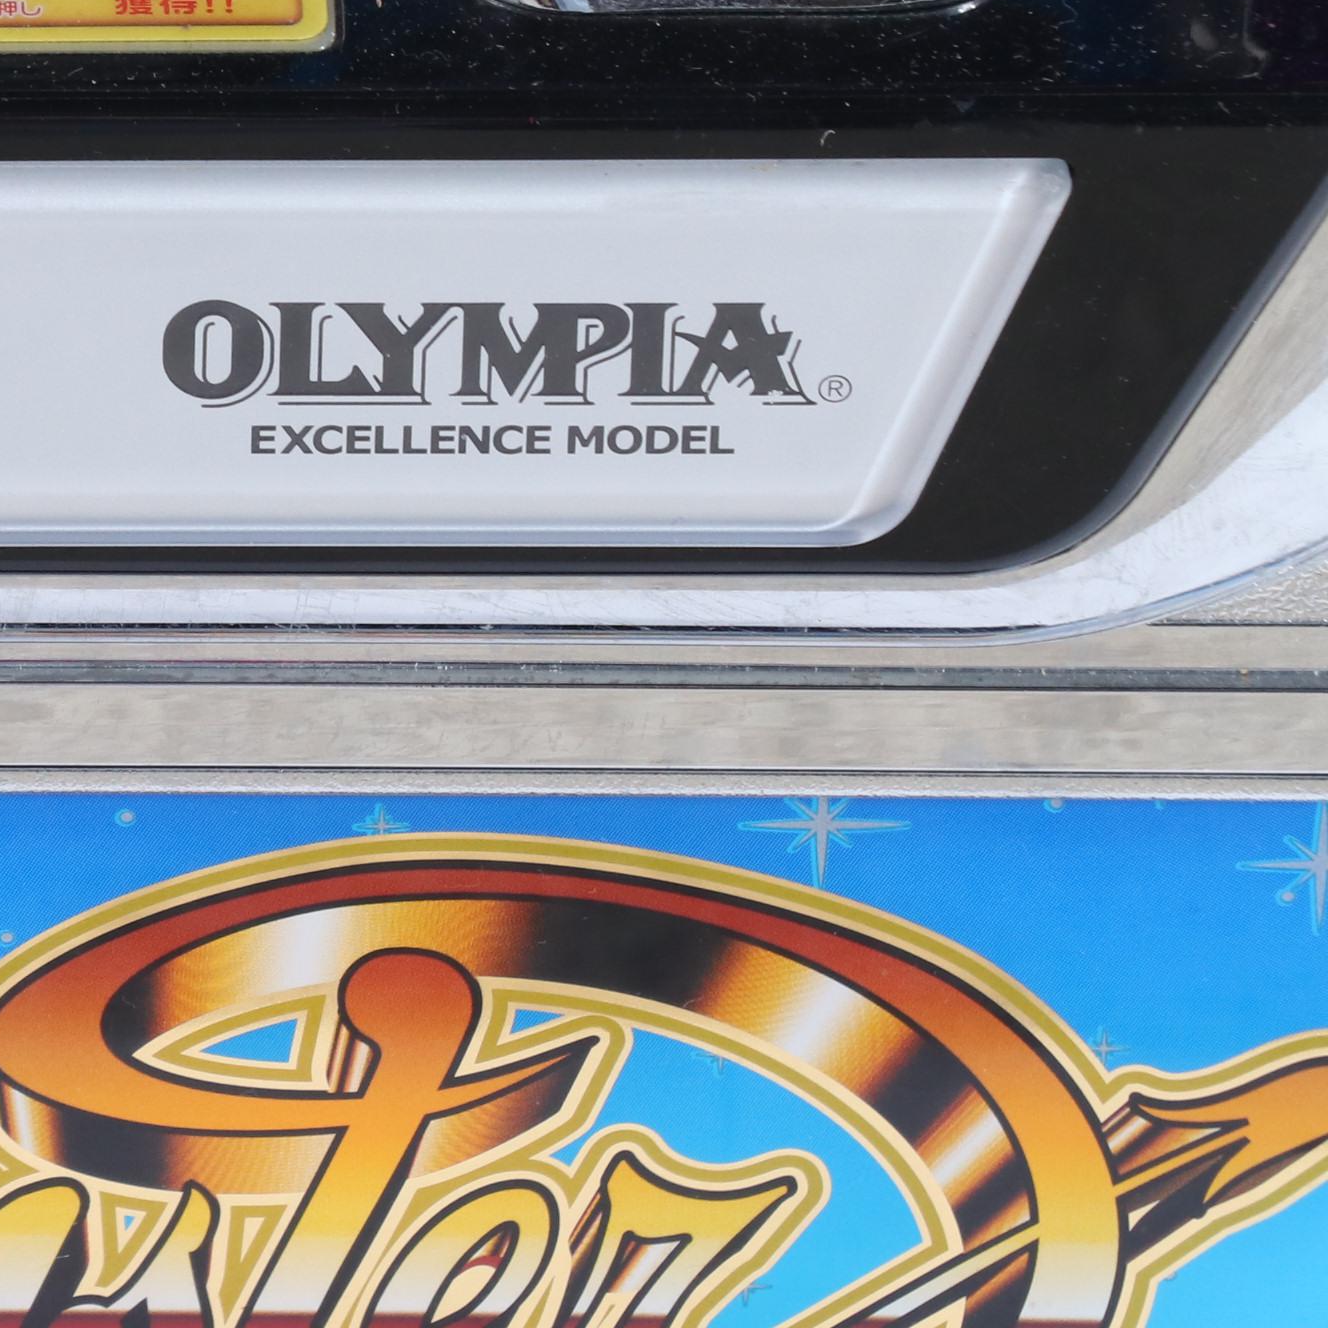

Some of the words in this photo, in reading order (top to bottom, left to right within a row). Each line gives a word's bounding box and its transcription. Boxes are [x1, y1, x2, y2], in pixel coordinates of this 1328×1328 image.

[162, 298, 818, 409] OLYMPIA
[250, 424, 551, 455] EXCELLENCE
[566, 424, 734, 455] MODEL
